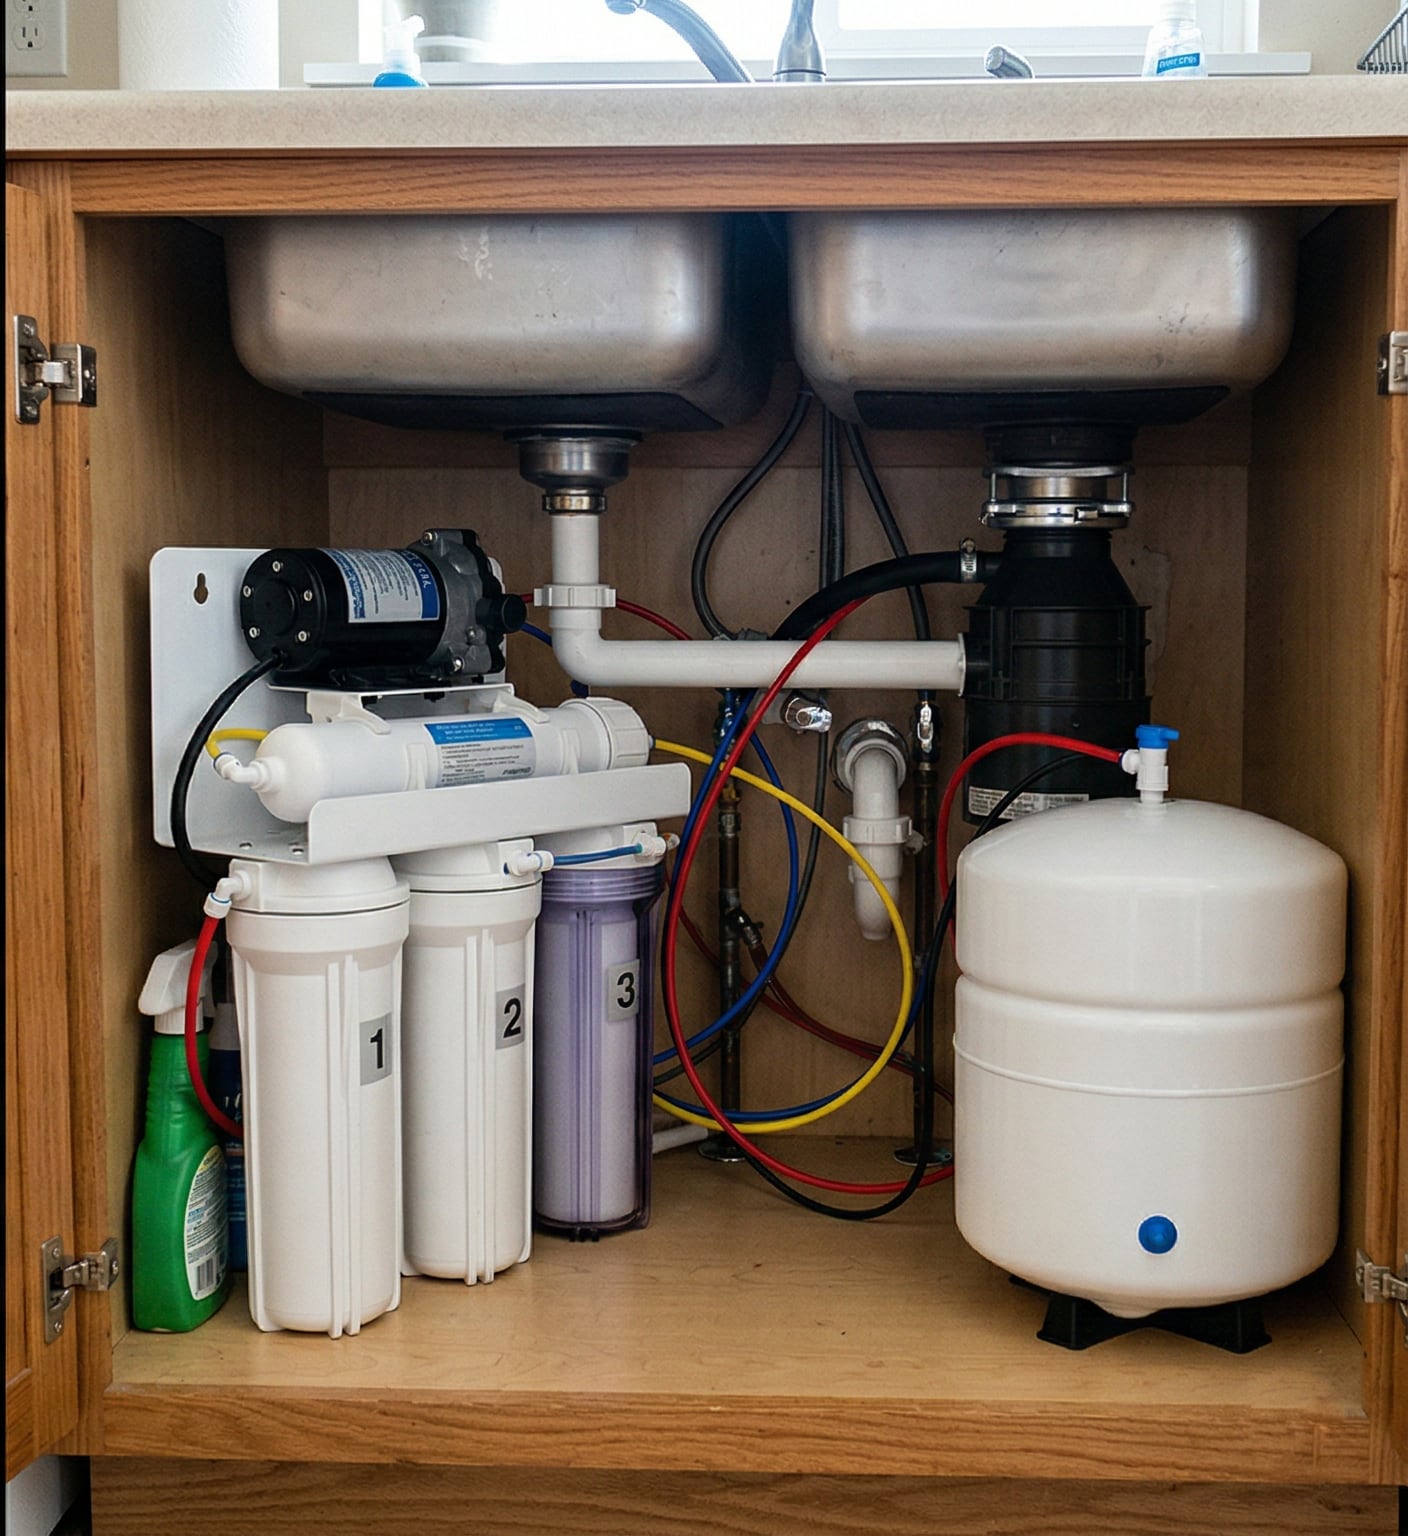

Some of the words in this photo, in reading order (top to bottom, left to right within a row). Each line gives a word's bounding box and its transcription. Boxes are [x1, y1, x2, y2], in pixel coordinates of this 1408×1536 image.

[616, 972, 636, 1009] 3
[503, 998, 522, 1039] 2
[369, 1028, 384, 1069] 1
